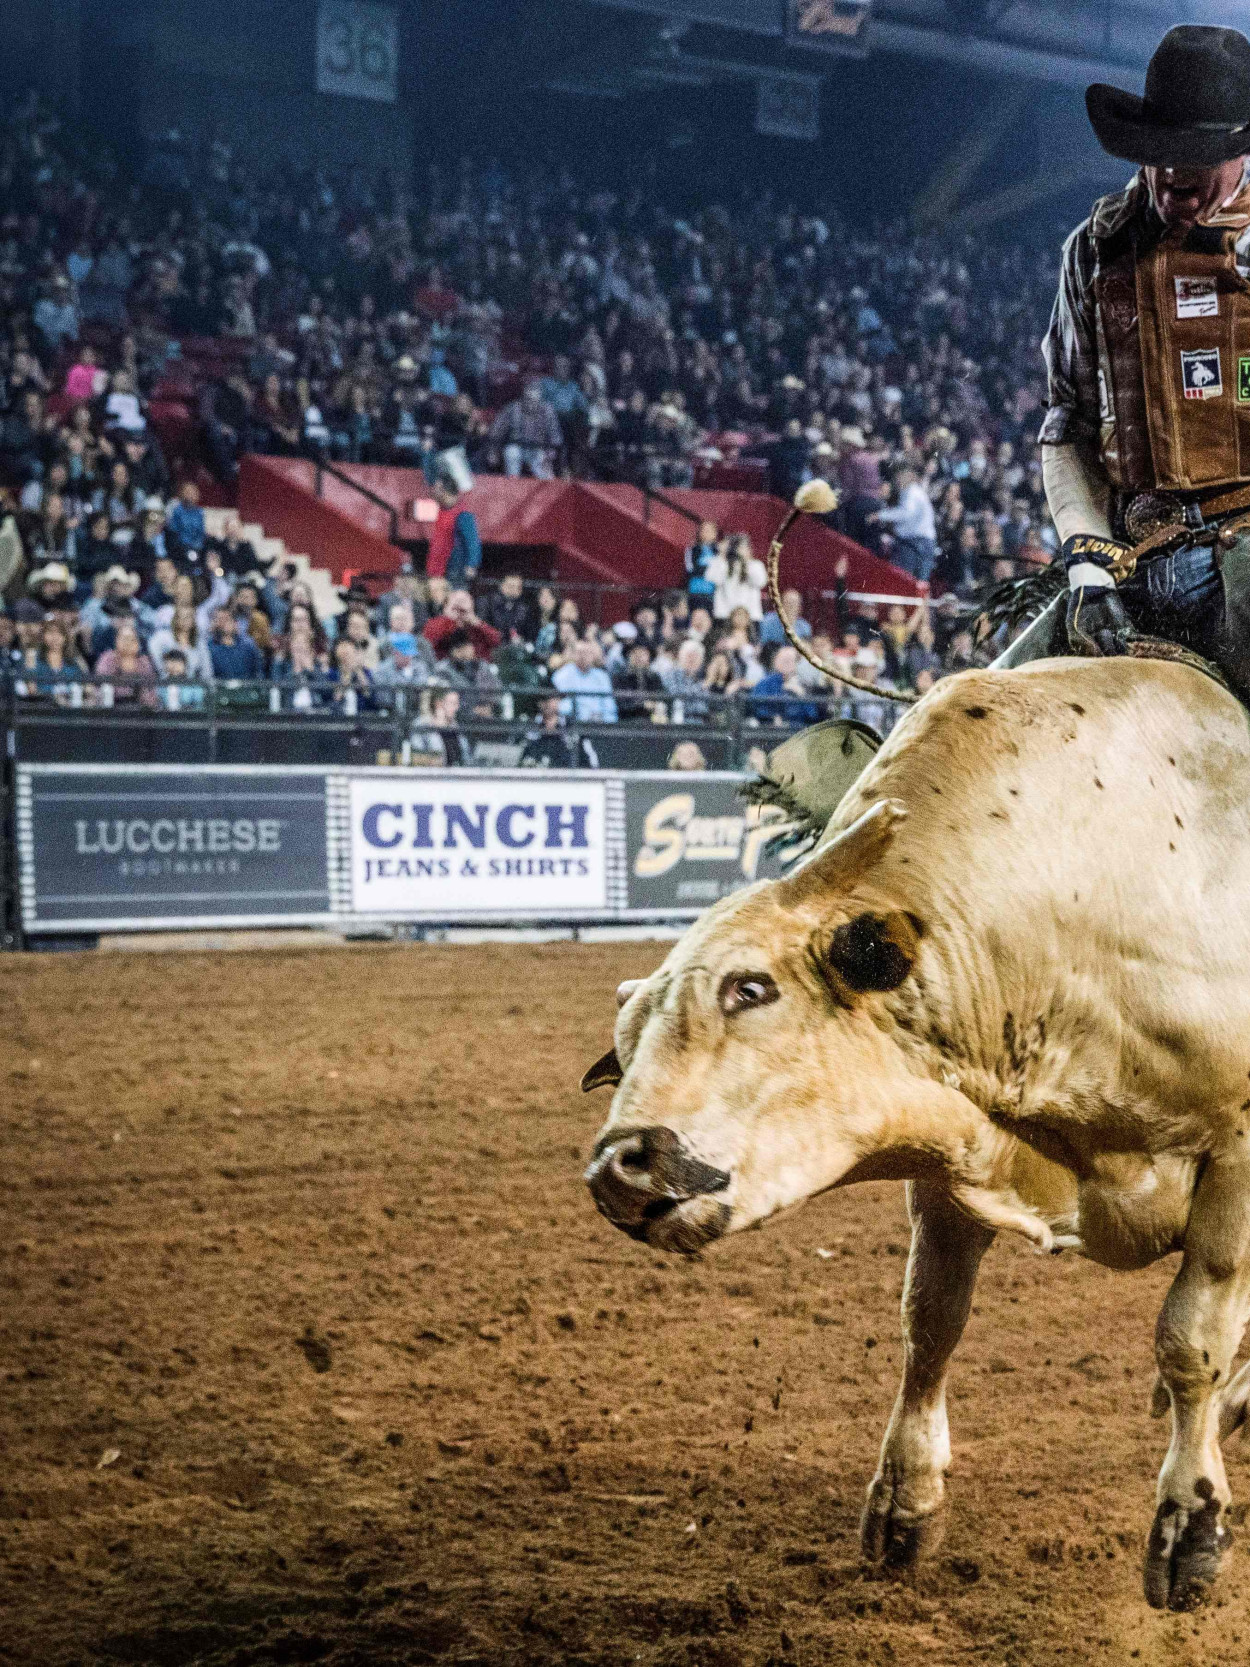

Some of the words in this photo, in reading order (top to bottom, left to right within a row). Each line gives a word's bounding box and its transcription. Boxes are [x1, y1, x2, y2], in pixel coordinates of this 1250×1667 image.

[75, 818, 282, 853] LUCCHESE
[362, 803, 590, 849] CINCH
[365, 857, 450, 882] JEANS
[460, 857, 479, 877] &
[489, 857, 589, 877] SHIRTS
